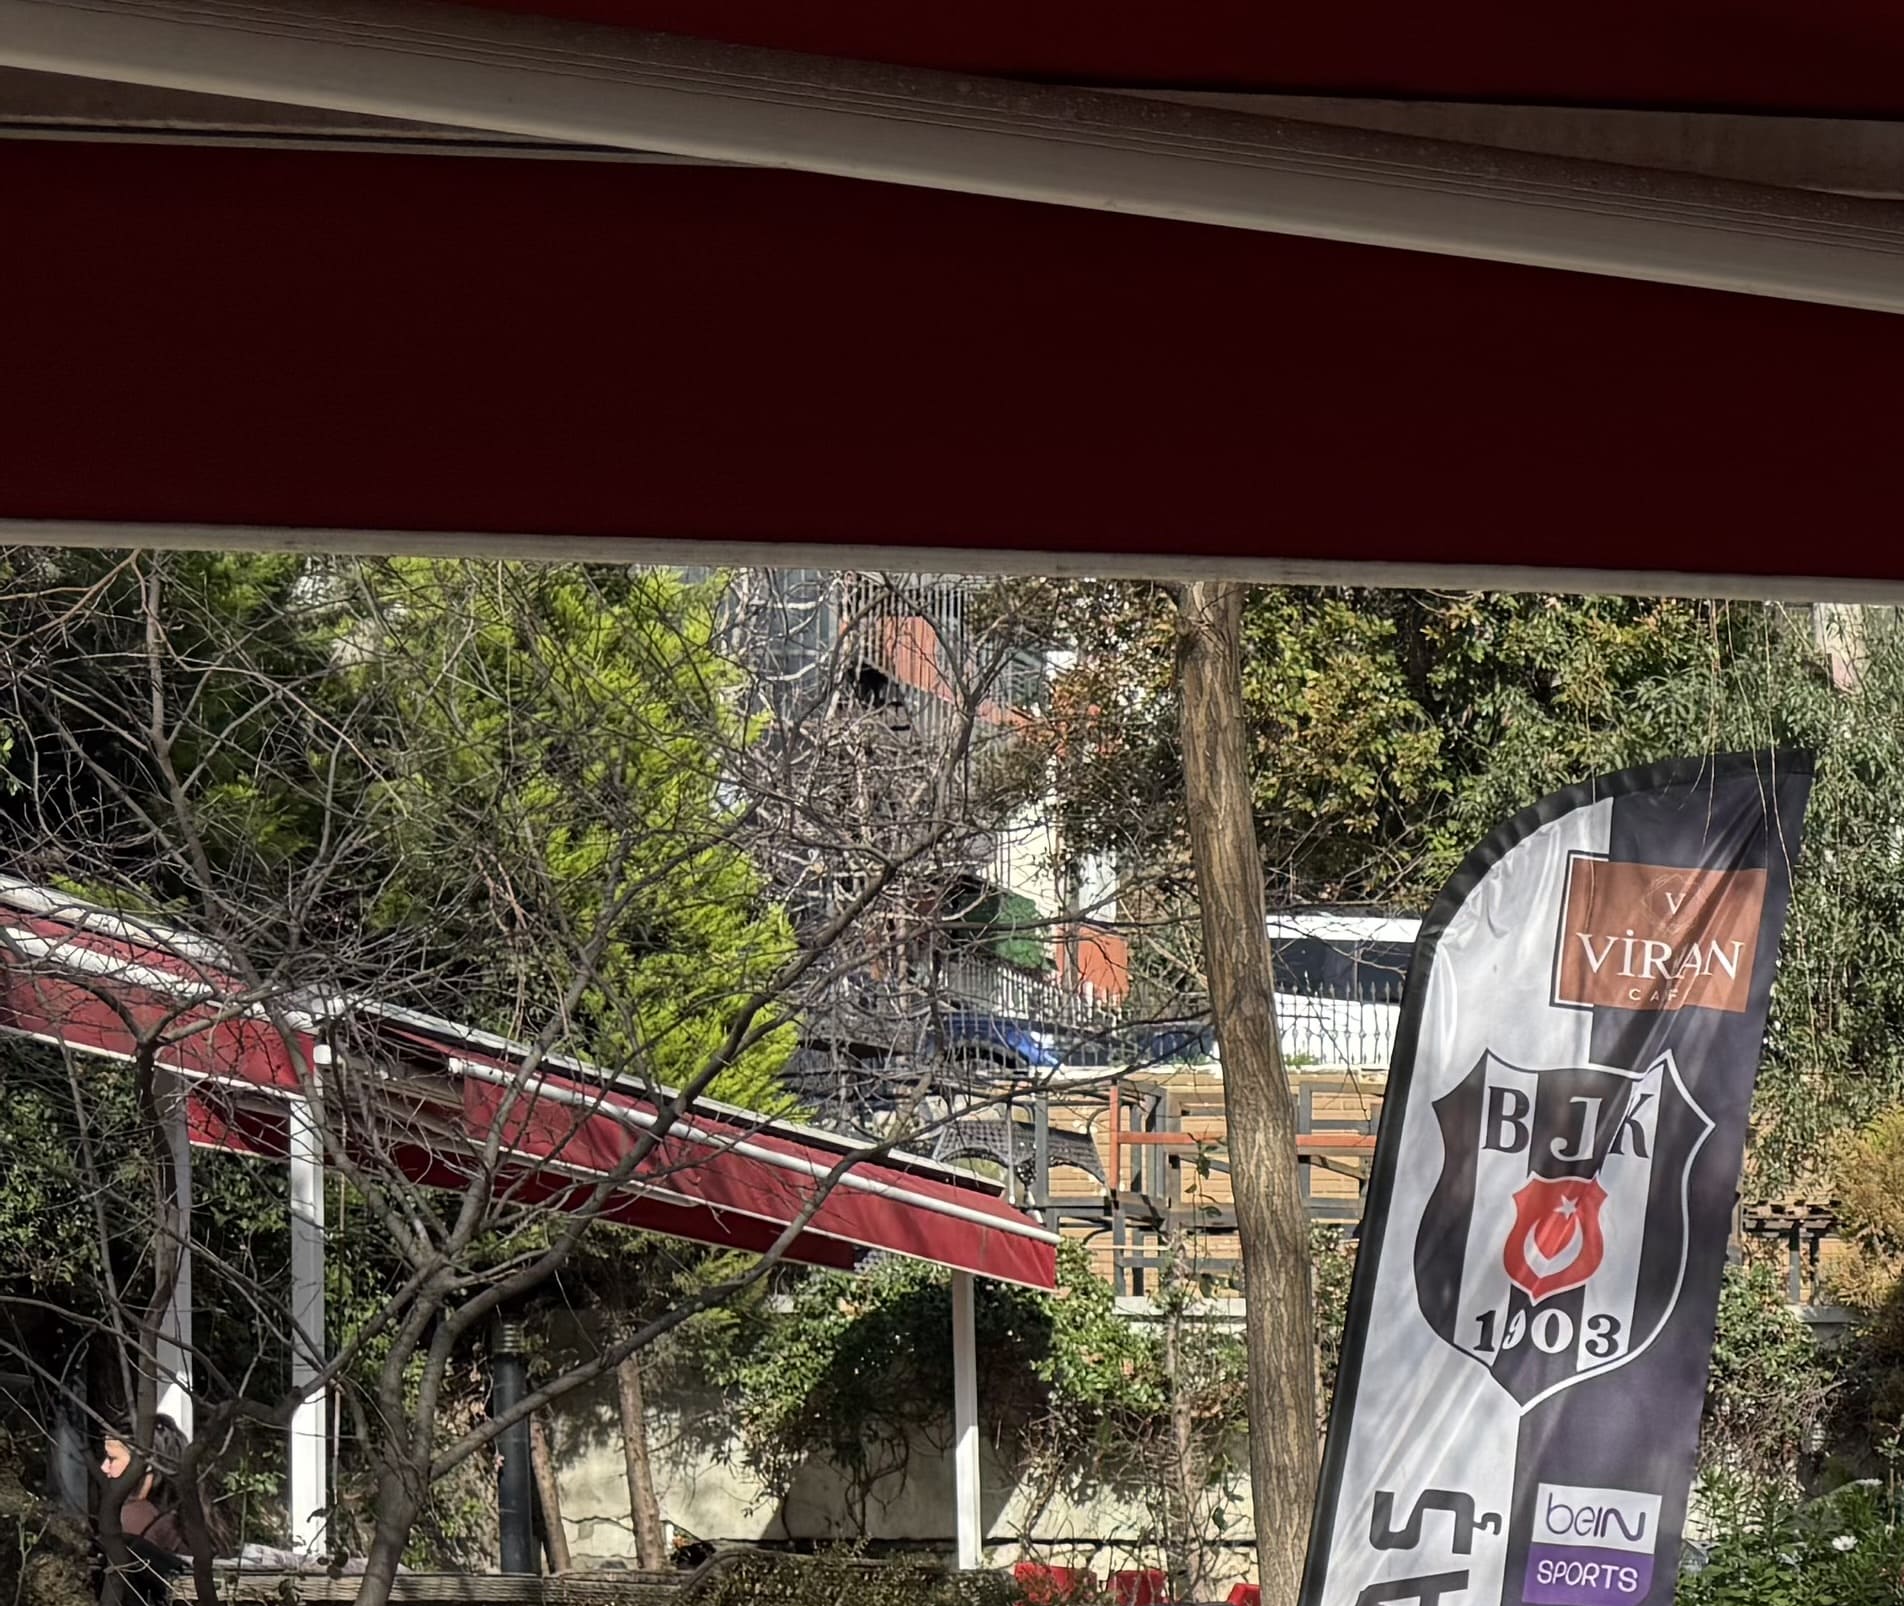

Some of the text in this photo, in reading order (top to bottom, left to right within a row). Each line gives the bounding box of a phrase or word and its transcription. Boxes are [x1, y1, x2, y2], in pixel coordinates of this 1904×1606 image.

[1664, 891, 1686, 915] V
[1575, 928, 1745, 980] VİRAN
[1628, 987, 1679, 1001] CAF
[1482, 1085, 1651, 1159] BJK
[1472, 1306, 1623, 1358] 1903
[1536, 1559, 1638, 1594] SPORTS
